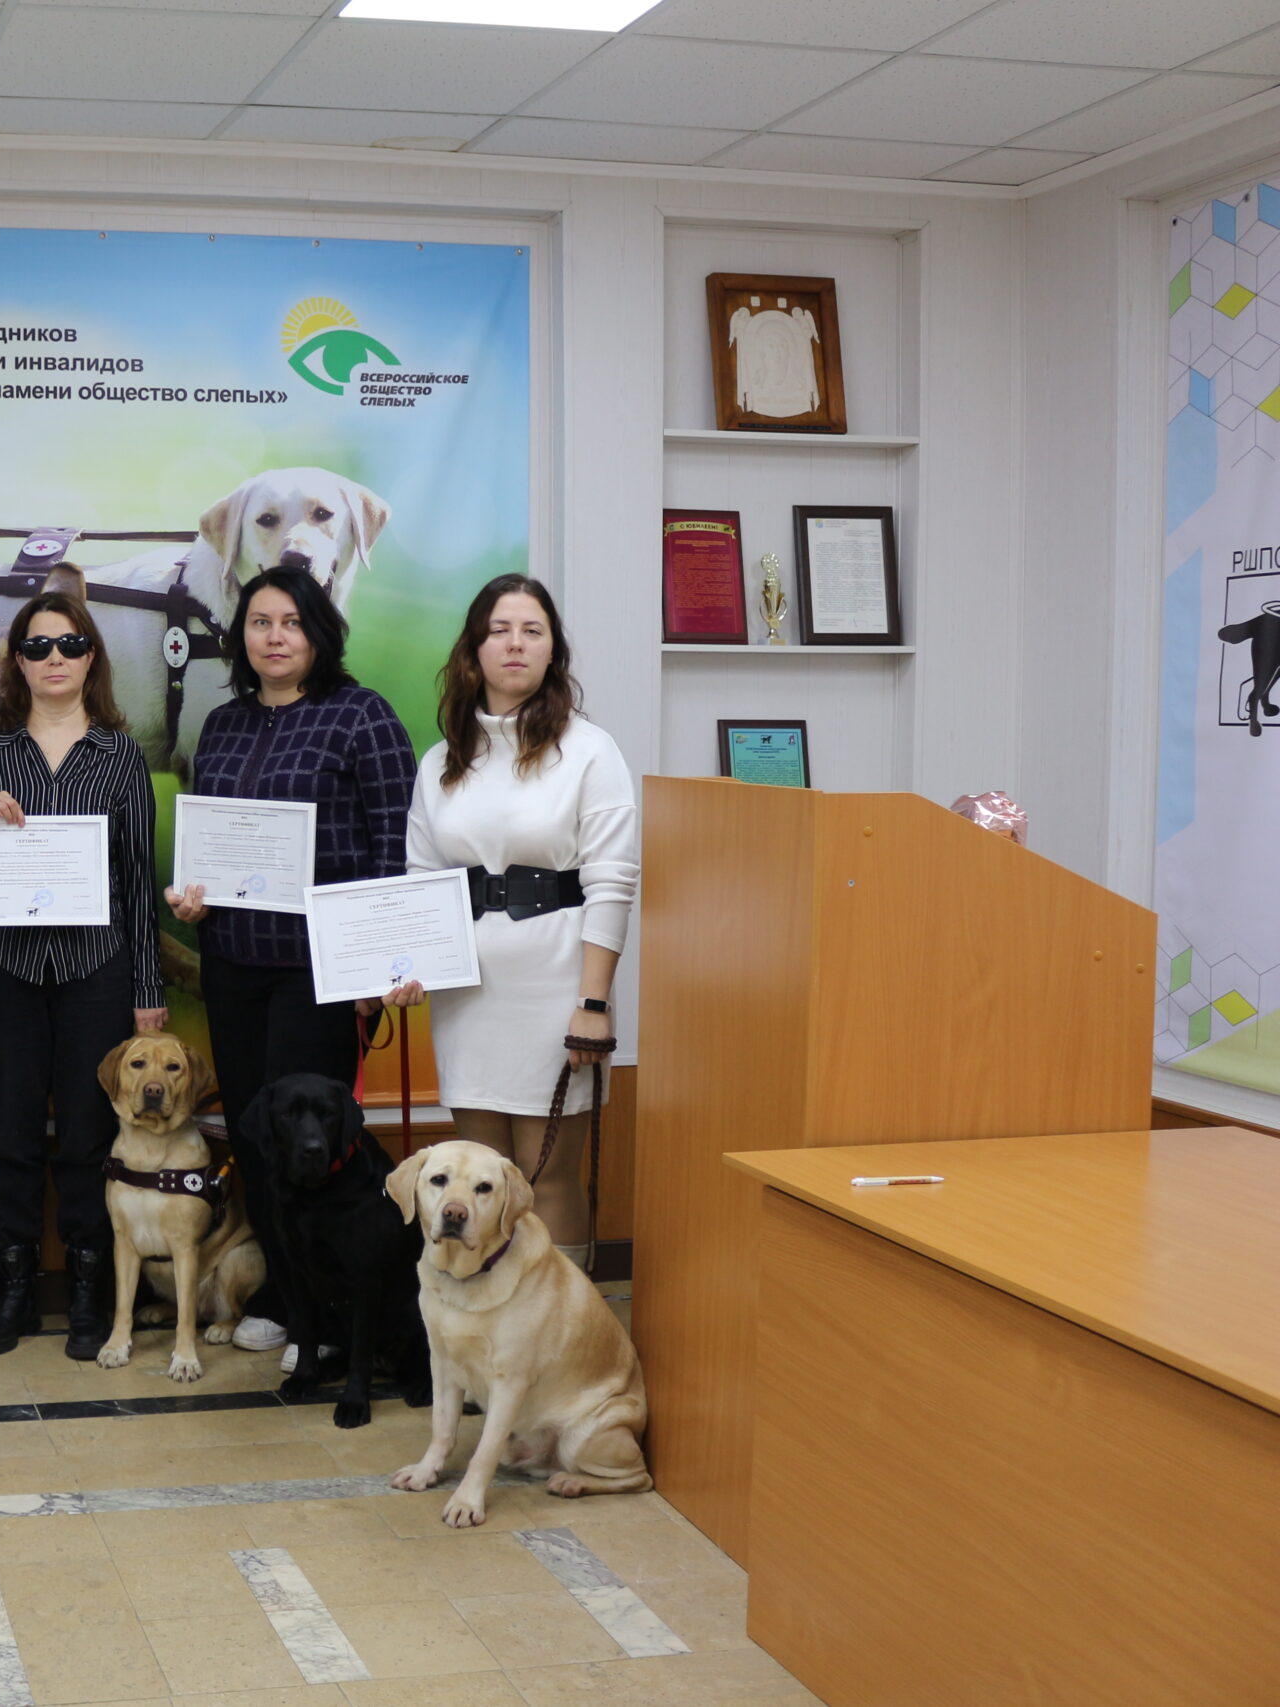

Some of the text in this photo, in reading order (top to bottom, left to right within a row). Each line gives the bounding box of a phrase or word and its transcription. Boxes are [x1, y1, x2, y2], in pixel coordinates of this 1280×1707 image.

[14, 355, 144, 376] инвалидов
[359, 371, 470, 385] ВСЕРОССИЙСКОЕ
[77, 381, 188, 406] общество
[193, 385, 289, 405] слепых»
[359, 384, 433, 397] ОБЩЕСТВО
[359, 396, 417, 408] СЛЕПЫХ
